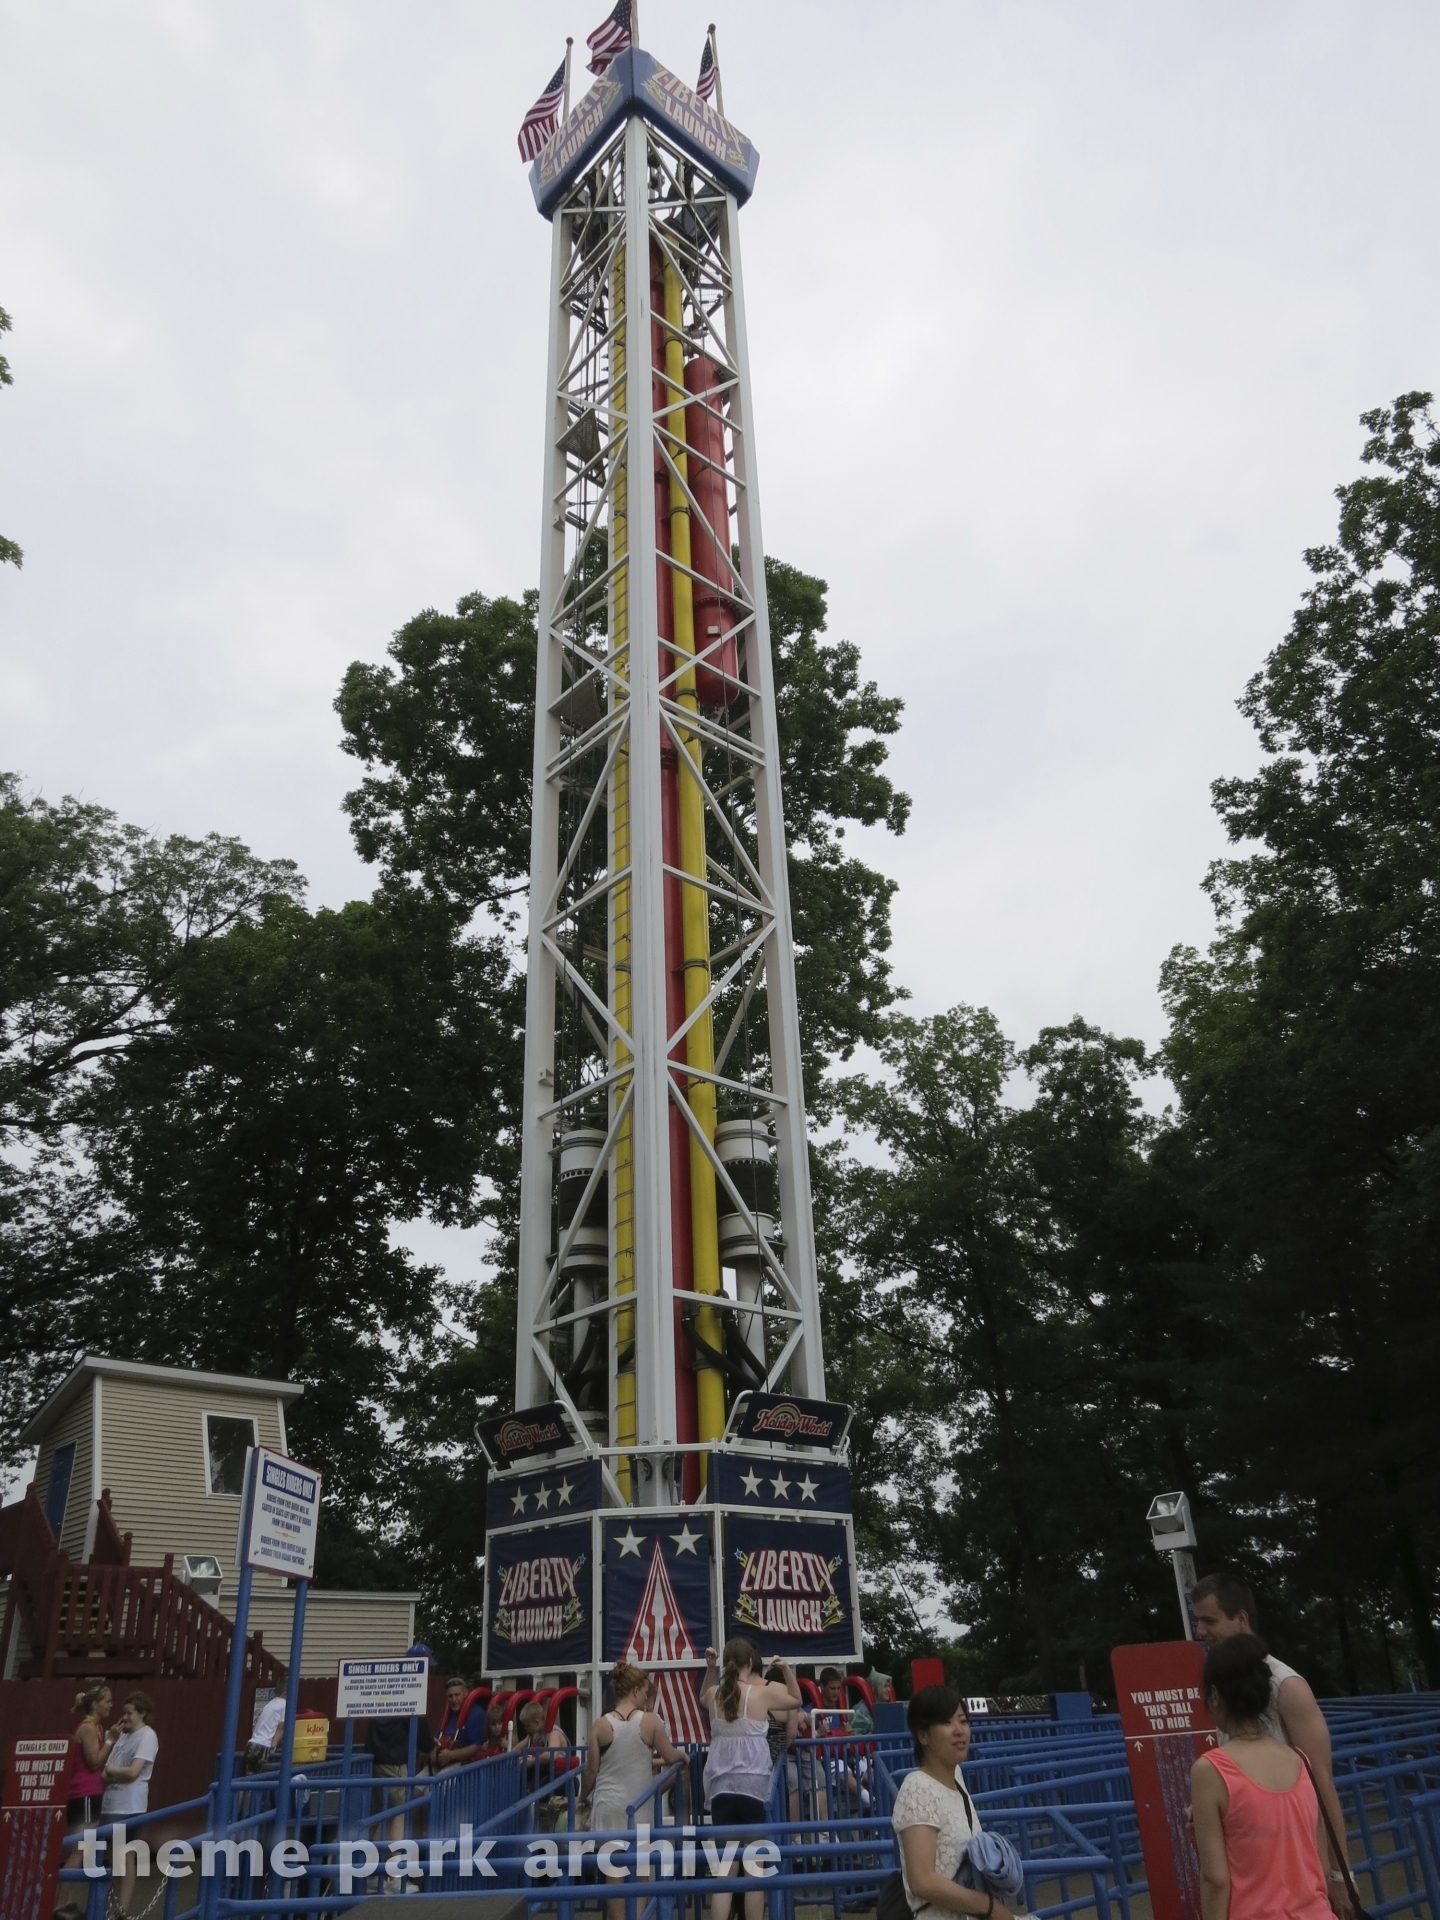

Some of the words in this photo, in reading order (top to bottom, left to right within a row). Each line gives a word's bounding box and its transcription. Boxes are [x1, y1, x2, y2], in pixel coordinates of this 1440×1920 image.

[652, 70, 742, 154] LIBERTY
[553, 101, 604, 176] LAUNCH
[664, 95, 727, 161] LAUNCH
[753, 1409, 800, 1437] Holiday
[799, 1414, 832, 1436] World
[494, 1430, 533, 1456] Holiday
[525, 1424, 561, 1442] World
[266, 1465, 286, 1488] SINGLES
[286, 1473, 302, 1495] RIDERS
[303, 1480, 314, 1499] ONLY
[499, 1557, 577, 1606] LIBERTY
[741, 1550, 835, 1595] LIBERTY
[510, 1605, 562, 1643] LAUNCH
[758, 1599, 823, 1632] LAUNCH
[348, 1664, 372, 1674] SINGLE
[374, 1664, 400, 1673] RIDERS
[402, 1663, 419, 1672] ONLY
[1131, 1691, 1152, 1704] YOU
[1154, 1689, 1183, 1702] MUST
[1187, 1687, 1200, 1699] BE
[1143, 1704, 1168, 1717] THIS
[1170, 1702, 1193, 1714] TALL
[307, 1724, 324, 1735] igloo
[1150, 1718, 1164, 1730] TO
[1167, 1716, 1191, 1729] RIDE
[18, 1743, 47, 1751] SINGLES
[48, 1742, 66, 1751] ONLY
[15, 1760, 30, 1772] YOU
[31, 1760, 54, 1772] MUST
[55, 1760, 65, 1772] BE
[20, 1774, 38, 1787] THIS
[39, 1774, 55, 1786] TALL
[21, 1789, 31, 1801] TO
[32, 1788, 51, 1800] RIDE
